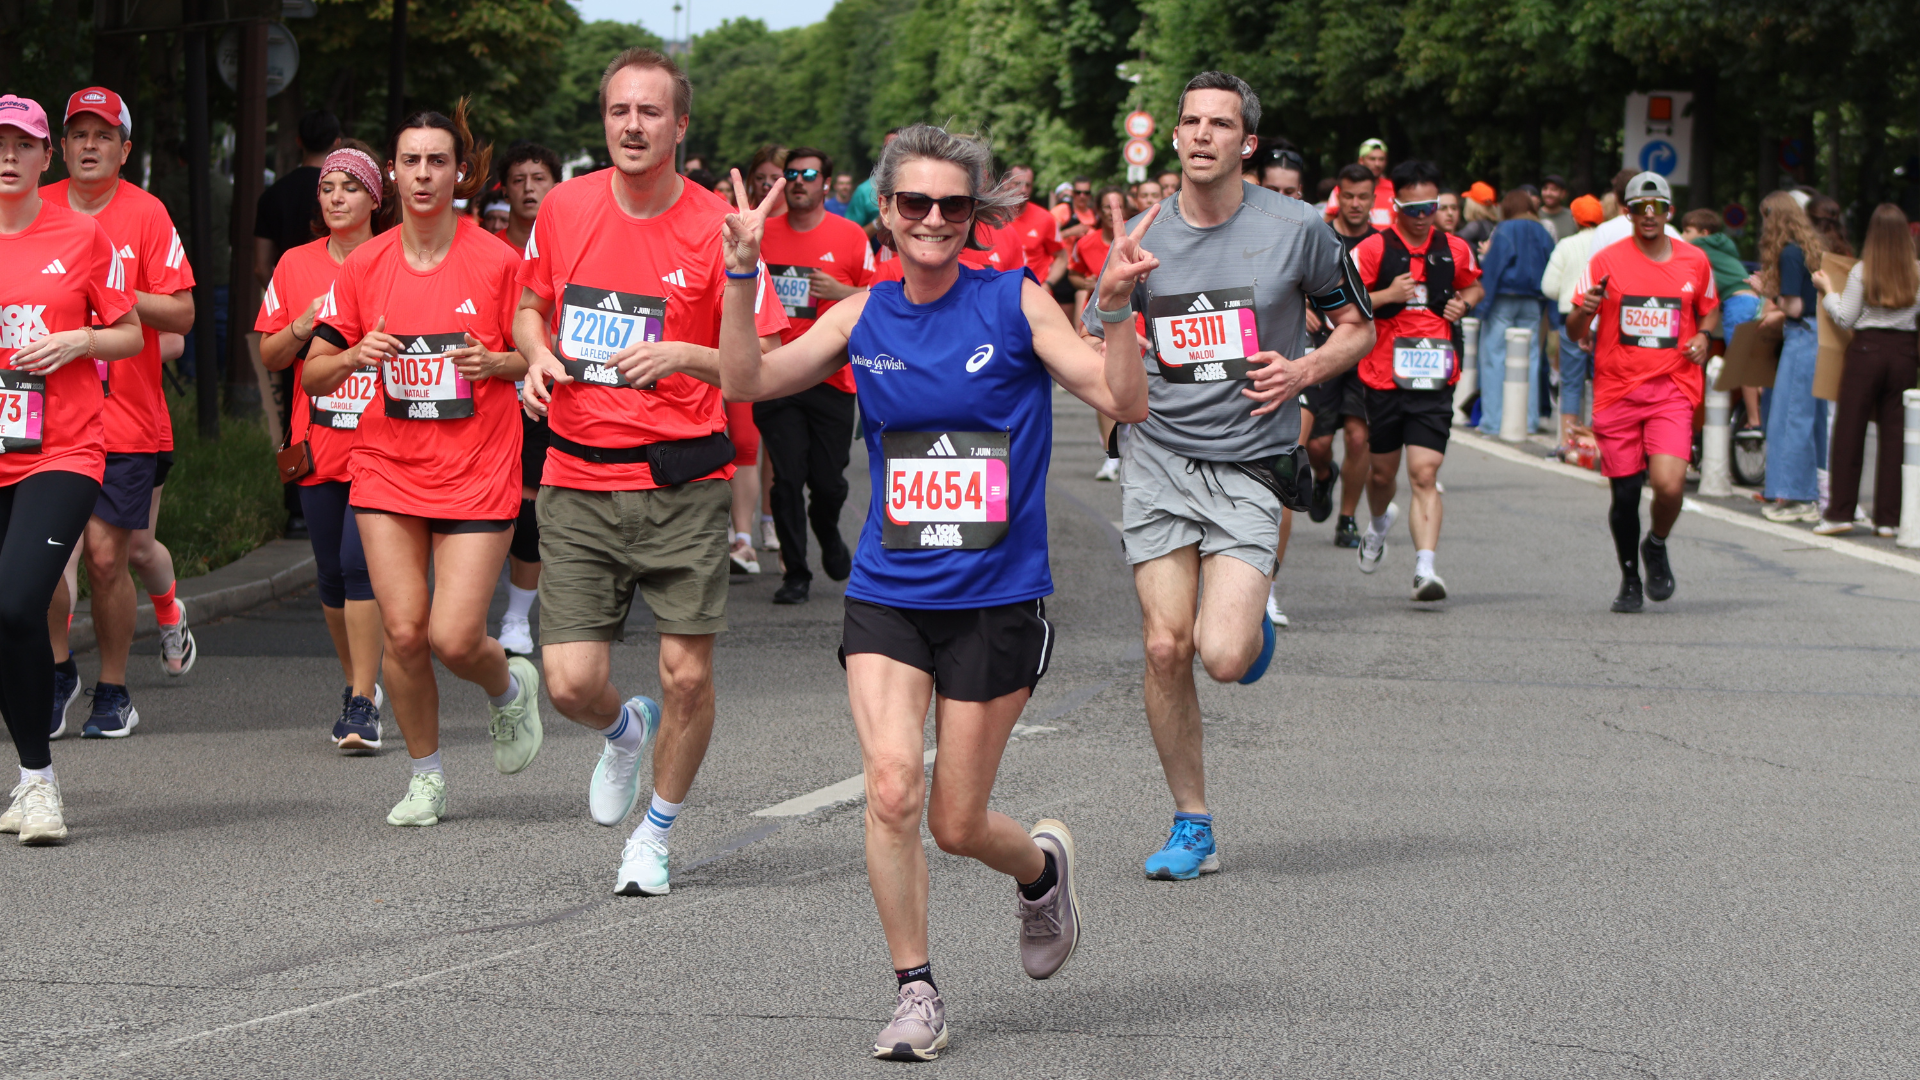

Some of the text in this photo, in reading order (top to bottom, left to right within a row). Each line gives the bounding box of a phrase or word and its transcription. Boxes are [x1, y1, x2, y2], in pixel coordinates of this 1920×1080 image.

[772, 278, 807, 297] 6689
[1228, 300, 1241, 308] JUIN
[637, 307, 650, 315] JUIN
[1625, 309, 1668, 327] 52664
[571, 310, 635, 349] 22167
[1170, 315, 1226, 349] 53111
[580, 347, 617, 360] LA FLECH
[1188, 350, 1215, 360] MALOU
[1401, 350, 1439, 368] 21222
[390, 357, 444, 386] 51037
[1203, 362, 1226, 374] 10K
[583, 369, 619, 385] PARIS
[1194, 371, 1227, 381] PARIS
[326, 376, 371, 399] 802
[404, 389, 430, 397] NATALIE
[330, 401, 353, 410] CAROLE
[418, 402, 438, 411] 10K
[408, 409, 439, 418] PARIS
[970, 447, 1007, 456] 7 JUIN 2026
[892, 471, 982, 510] 54654
[991, 486, 1000, 496] 1H
[935, 524, 960, 536] 10K
[921, 534, 963, 546] PARIS
